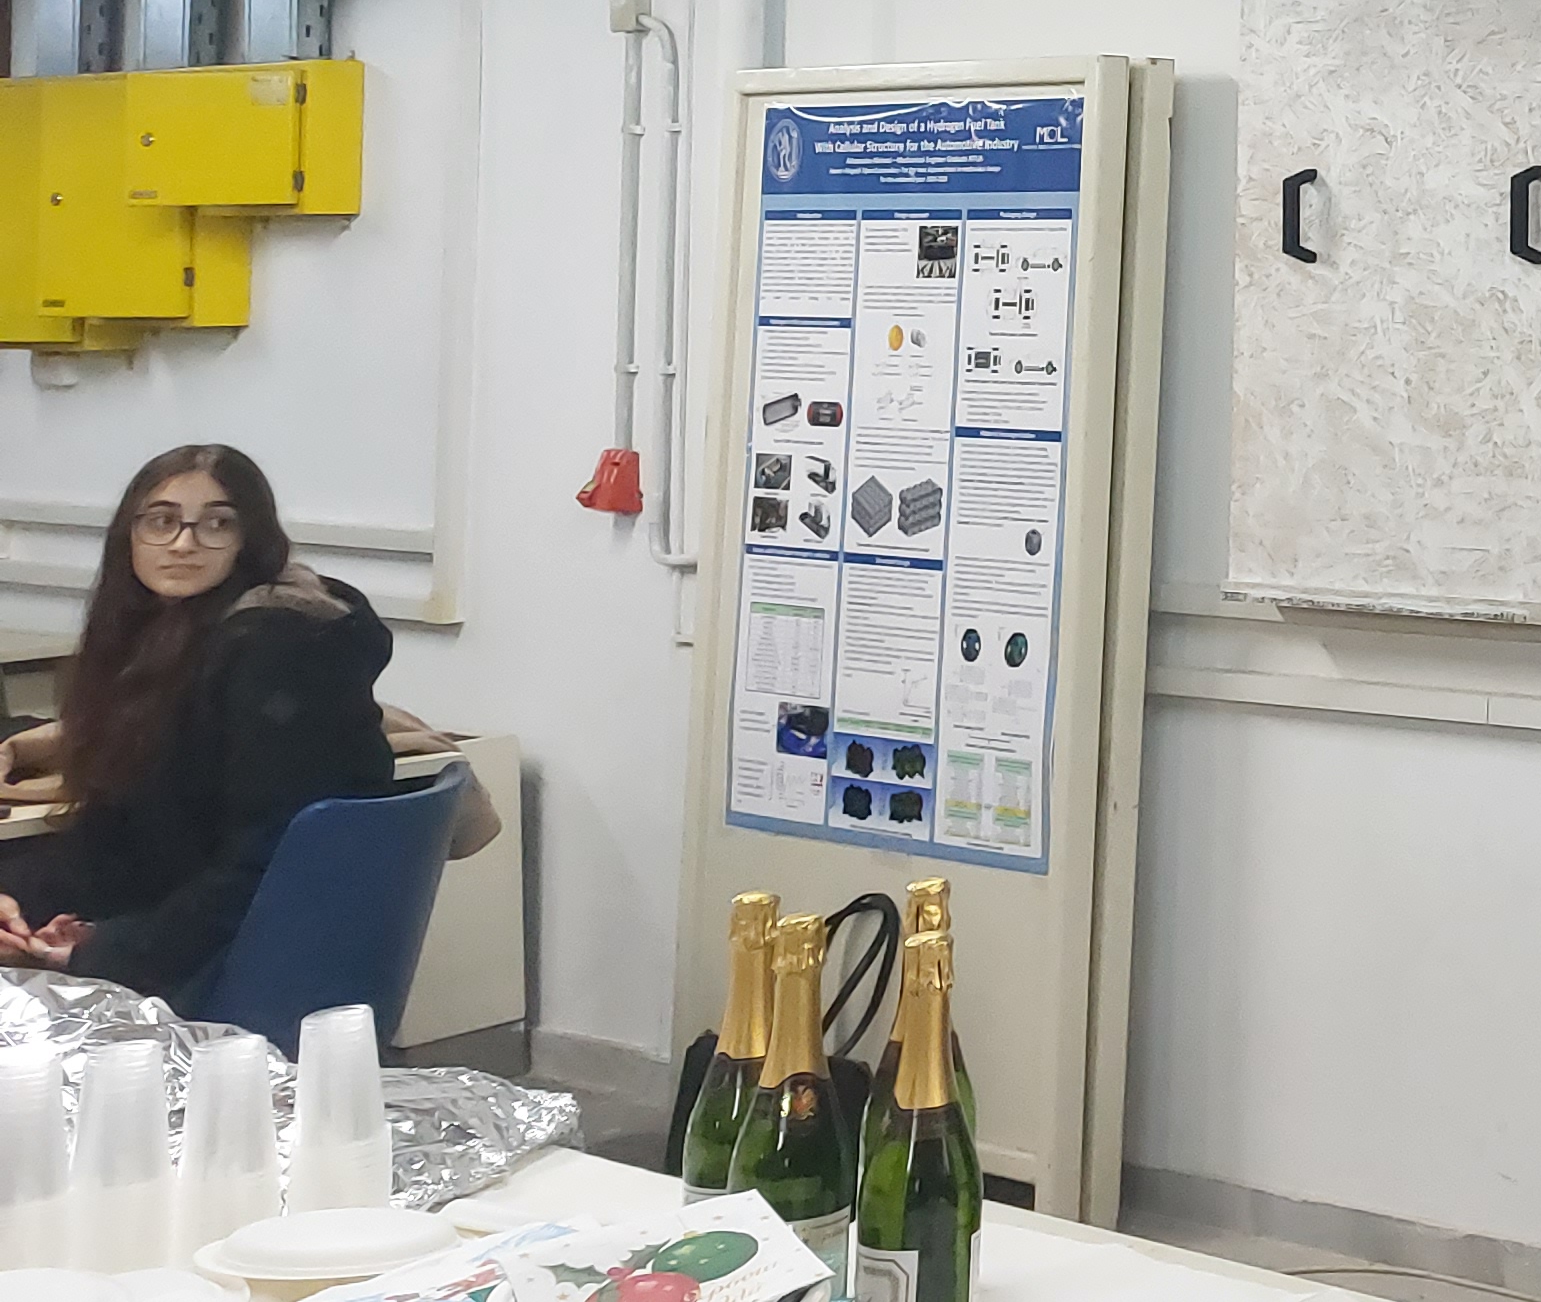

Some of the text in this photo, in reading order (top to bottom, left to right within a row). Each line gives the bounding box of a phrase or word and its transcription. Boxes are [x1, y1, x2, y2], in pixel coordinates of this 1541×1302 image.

[828, 118, 1005, 137] Analysis and Design of a Hydrogen Fuel Tank
[814, 140, 834, 153] With
[835, 140, 865, 152] Cellular
[906, 139, 919, 152] for
[920, 139, 935, 151] the
[936, 139, 984, 151] Automotive
[984, 138, 1019, 152] Industry
